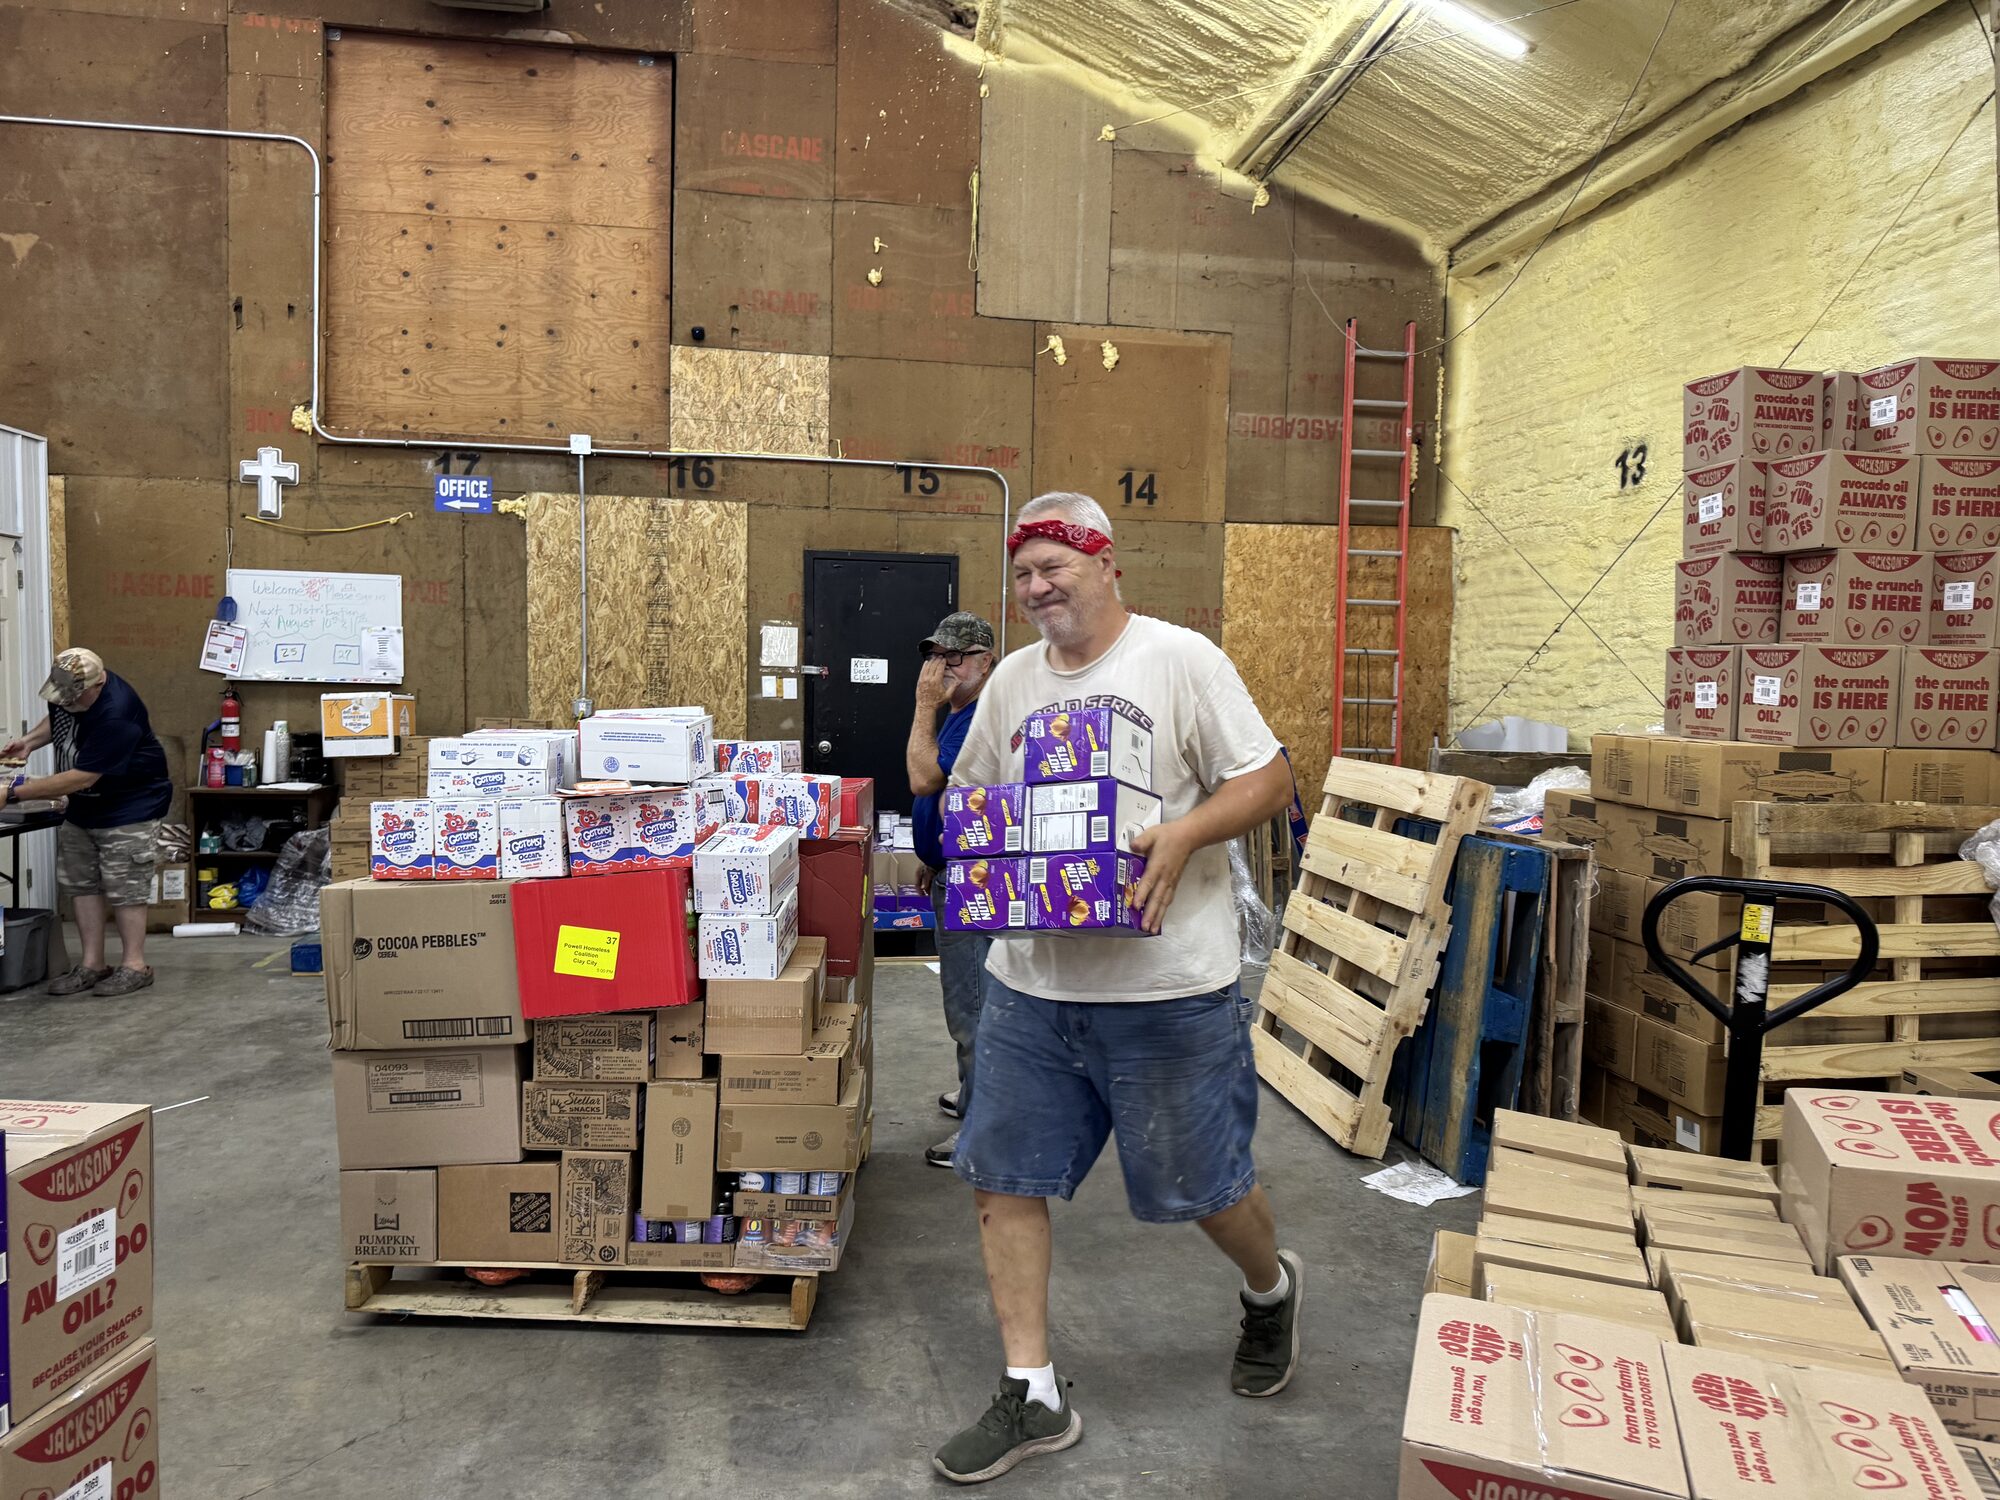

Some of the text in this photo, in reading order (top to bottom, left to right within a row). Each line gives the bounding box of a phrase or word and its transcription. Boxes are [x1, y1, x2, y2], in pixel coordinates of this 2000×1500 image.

[721, 131, 824, 162] CASCADE
[1871, 370, 1906, 389] JACKSON'S
[1945, 363, 1988, 379] JACKSON'S
[1696, 376, 1731, 396] JACKSON'S
[1767, 374, 1804, 388] JACKSON'S
[1754, 393, 1815, 406] avocado oil
[1929, 385, 2000, 401] the crunch
[1708, 405, 1730, 421] YUM
[1754, 405, 1814, 423] ALWAYS
[1929, 402, 2000, 421] IS HERE
[1685, 428, 1709, 445] WOW
[1874, 426, 1898, 442] OIL?
[1712, 433, 1732, 454] YES
[435, 453, 481, 475] 17
[670, 456, 714, 489] 16
[1615, 444, 1648, 488] 13
[1780, 458, 1815, 477] JACKSON'S
[1855, 458, 1897, 474] JACKSON'S
[1949, 461, 1992, 476] JACKSON'S
[897, 465, 940, 495] 15
[1696, 468, 1727, 486] JACKSON'S
[1795, 480, 1813, 489] SUPER
[1840, 479, 1909, 492] avocado oil
[439, 479, 488, 498] OFFICE
[1117, 472, 1158, 505] 14
[1791, 488, 1813, 506] YUM
[1932, 483, 1957, 497] the
[1839, 492, 1907, 510] ALWAYS
[1932, 499, 1951, 516] IS
[1766, 510, 1790, 527] WOW
[1791, 512, 1809, 527] SUPER
[1700, 522, 1721, 537] OIL?
[1792, 520, 1813, 540] YES
[1685, 560, 1713, 577] JACKSON'S
[1796, 557, 1827, 573] JACKSON'S
[1866, 554, 1910, 570] JACKSON'S
[1945, 555, 1984, 572] JACKSON'S
[253, 580, 304, 597] Welcome
[1848, 577, 1923, 592] the crunch
[1694, 587, 1711, 605] YUM
[1848, 593, 1922, 612] IS HERE
[248, 601, 281, 616] Next
[1676, 606, 1695, 622] WOW
[277, 616, 314, 632] August
[1697, 617, 1713, 636] YES
[1797, 613, 1820, 626] OIL?
[1946, 614, 1974, 627] OIL?
[280, 648, 297, 658] 25
[1693, 653, 1722, 667] JACKSON'S
[1755, 652, 1790, 668] JACKSON'S
[1831, 651, 1876, 666] JACKSON'S
[1932, 653, 1976, 668] JACKSON'S
[853, 660, 876, 668] KEEP
[1814, 674, 1889, 689] the crunch
[1914, 675, 1990, 691] the crunch
[1813, 691, 1888, 710] IS HERE
[1914, 692, 1989, 711] IS HERE
[1085, 695, 1155, 731] SERIES
[1695, 708, 1715, 720] OIL?
[1757, 709, 1781, 723] OIL?
[1046, 752, 1063, 772] HOT
[1055, 745, 1074, 772] NUTS
[653, 835, 674, 844] Ocean
[963, 827, 979, 847] HOT
[972, 820, 989, 846] NUTS
[591, 840, 611, 849] Ocean
[518, 851, 542, 861] Ocean
[1064, 863, 1084, 891] NUTS
[1075, 863, 1093, 884] HOT
[966, 900, 982, 921] HOT
[974, 893, 992, 920] NUTS
[377, 936, 419, 951] COCOA
[583, 945, 610, 953] Homeless
[606, 936, 618, 945] 37
[377, 951, 399, 959] CEREAL
[573, 951, 599, 959] Coalition
[586, 959, 598, 967] City
[575, 1024, 613, 1038] Stellar
[374, 1063, 409, 1072] 04093
[564, 1091, 601, 1106] Stellar
[1876, 1098, 1962, 1165] IS HERE
[1923, 1102, 2000, 1167] the crunch
[46, 1137, 124, 1196] JACKSON'S
[569, 1186, 584, 1223] Stellar
[1903, 1181, 1950, 1256] WOW
[1948, 1196, 1969, 1248] SUPER
[65, 1228, 89, 1244] JACKSON'S
[92, 1219, 105, 1235] 2069
[359, 1235, 416, 1246] PUMPKIN
[354, 1245, 421, 1256] BREAD KIT
[62, 1278, 117, 1335] OIL?
[32, 1305, 143, 1390] BECAUSE YOUR SNACKS
[1437, 1319, 1471, 1359] HERO!
[1470, 1322, 1506, 1365] SNACK
[1507, 1340, 1522, 1361] HEY
[50, 1330, 129, 1391] DESERVE BETTER.
[1449, 1366, 1466, 1424] great taste!
[1466, 1374, 1487, 1426] You've got
[1612, 1356, 1643, 1445] from our family
[1691, 1373, 1733, 1414] HERO!
[1725, 1376, 1768, 1421] SNACK
[1634, 1361, 1662, 1449] TO YOUR DOORSTEP
[1767, 1396, 1789, 1418] HEY
[44, 1381, 130, 1457] JACKSON'S
[1719, 1420, 1755, 1484] great taste!
[1888, 1412, 1928, 1476] our family
[1746, 1430, 1777, 1485] You've got
[1910, 1416, 1960, 1494] YOUR DOORSTEP
